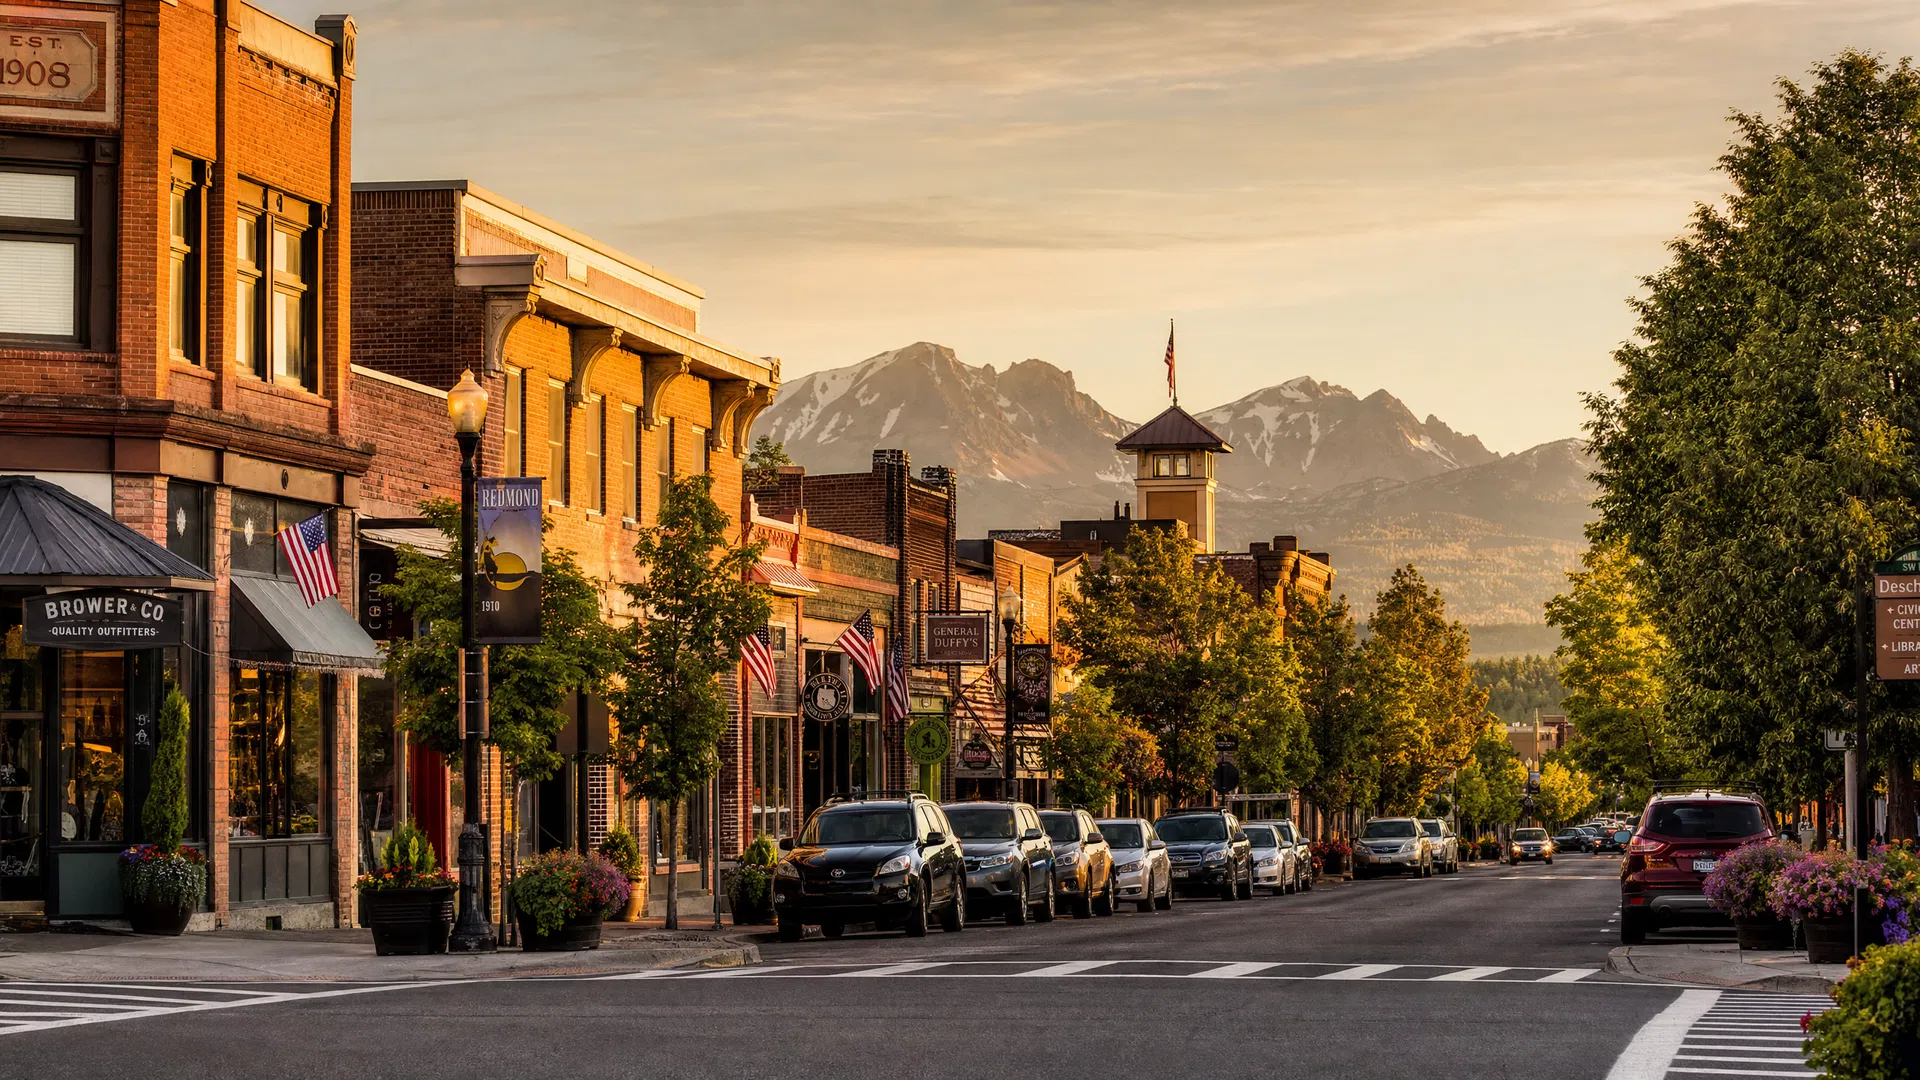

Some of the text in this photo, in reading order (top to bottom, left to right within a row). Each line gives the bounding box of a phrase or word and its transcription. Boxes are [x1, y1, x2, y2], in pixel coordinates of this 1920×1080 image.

[0, 58, 71, 88] 1908
[482, 488, 539, 507] REDMOND
[1902, 563, 1916, 572] SW
[44, 597, 128, 620] BROWER
[130, 603, 137, 612] &
[482, 600, 500, 612] 1910
[933, 627, 979, 636] GENERAL
[934, 637, 979, 648] DUFFY'S
[1904, 663, 1920, 674] AR
